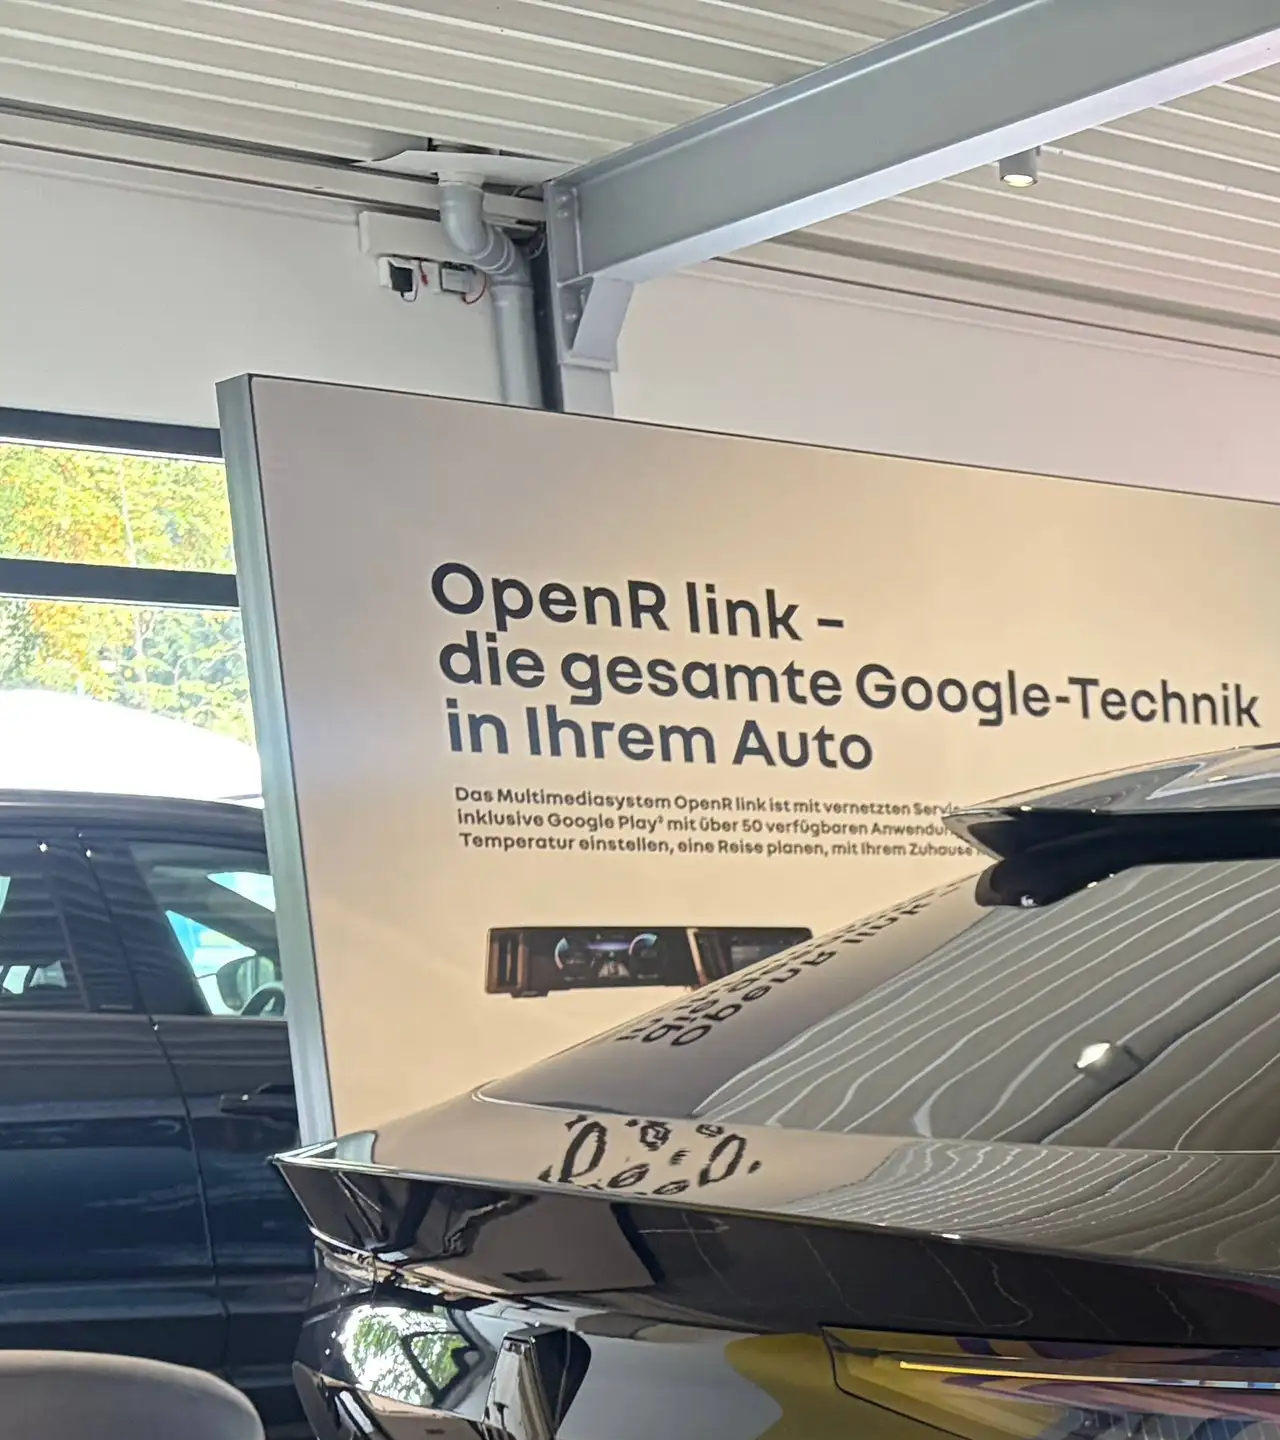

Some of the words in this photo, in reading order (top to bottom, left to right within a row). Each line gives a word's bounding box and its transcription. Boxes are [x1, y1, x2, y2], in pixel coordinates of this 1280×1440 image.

[431, 562, 670, 632] OpenR
[686, 582, 803, 641] link
[439, 631, 545, 687] die
[561, 651, 842, 705] gesamte
[856, 663, 1261, 728] Google-Technik
[446, 698, 508, 754] in
[526, 704, 716, 765] Ihrem
[732, 719, 872, 770] Auto
[455, 787, 493, 802] Das
[498, 789, 671, 811] Multimediasystem
[674, 795, 732, 813] OpenR
[735, 797, 766, 813] link
[769, 798, 789, 813] ist
[793, 800, 820, 815] mit
[823, 802, 911, 816] vernetzten
[457, 809, 544, 828] inklusive
[548, 812, 615, 832] Google
[667, 816, 697, 833] mit
[700, 816, 738, 833] über
[742, 819, 763, 834] 50
[766, 819, 867, 837] verfügbaren
[459, 832, 575, 852] Temperatur
[579, 835, 674, 855] einstellen,
[678, 837, 715, 854] eine
[718, 840, 763, 855] Reise
[767, 841, 828, 857] planen,
[832, 841, 859, 856] mit
[861, 841, 907, 856] Ihrem
[909, 843, 973, 858] Zuhause
